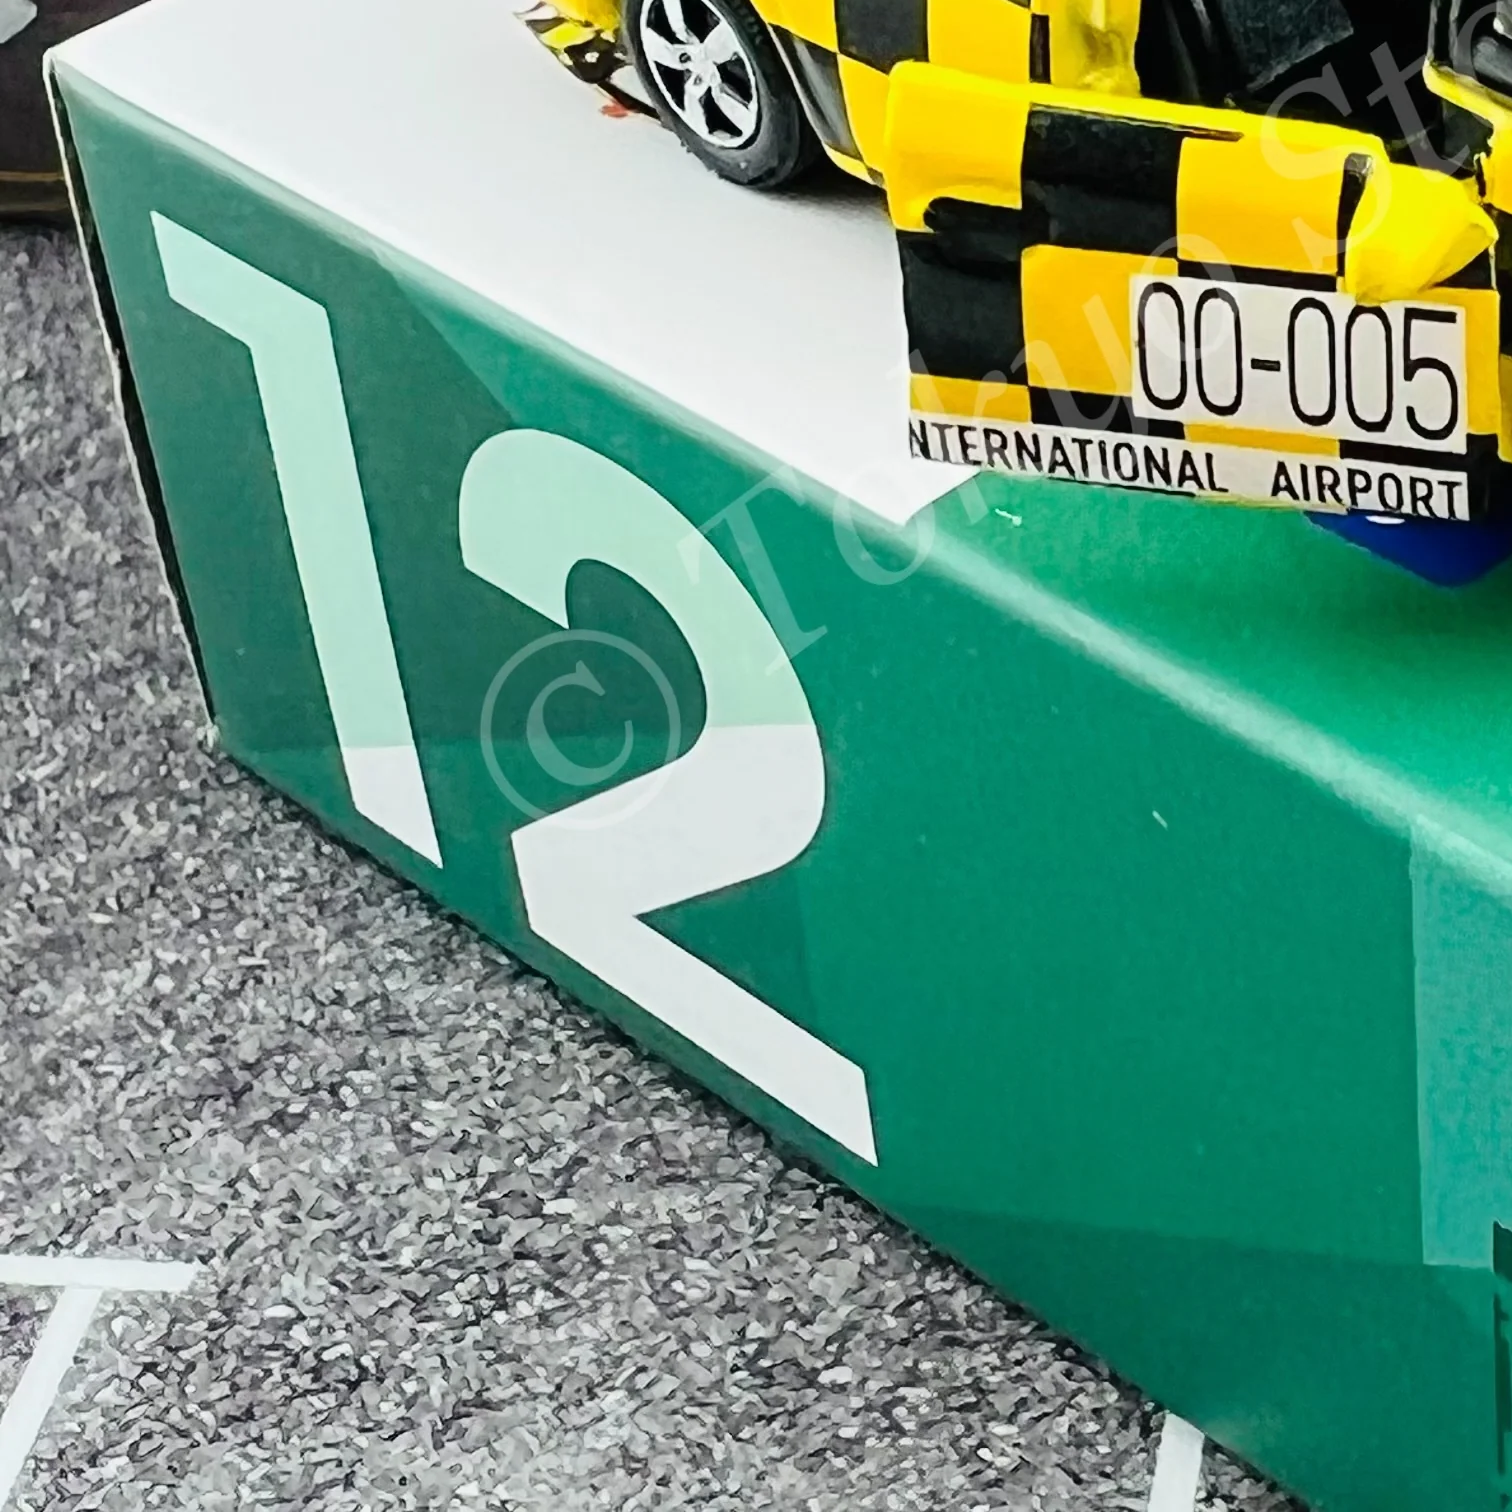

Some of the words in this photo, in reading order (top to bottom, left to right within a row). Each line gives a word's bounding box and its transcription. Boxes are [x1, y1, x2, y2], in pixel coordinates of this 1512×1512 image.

[1137, 281, 1459, 442] 00-005
[1270, 460, 1463, 520] AIRPORT
[150, 209, 878, 1166] 12
